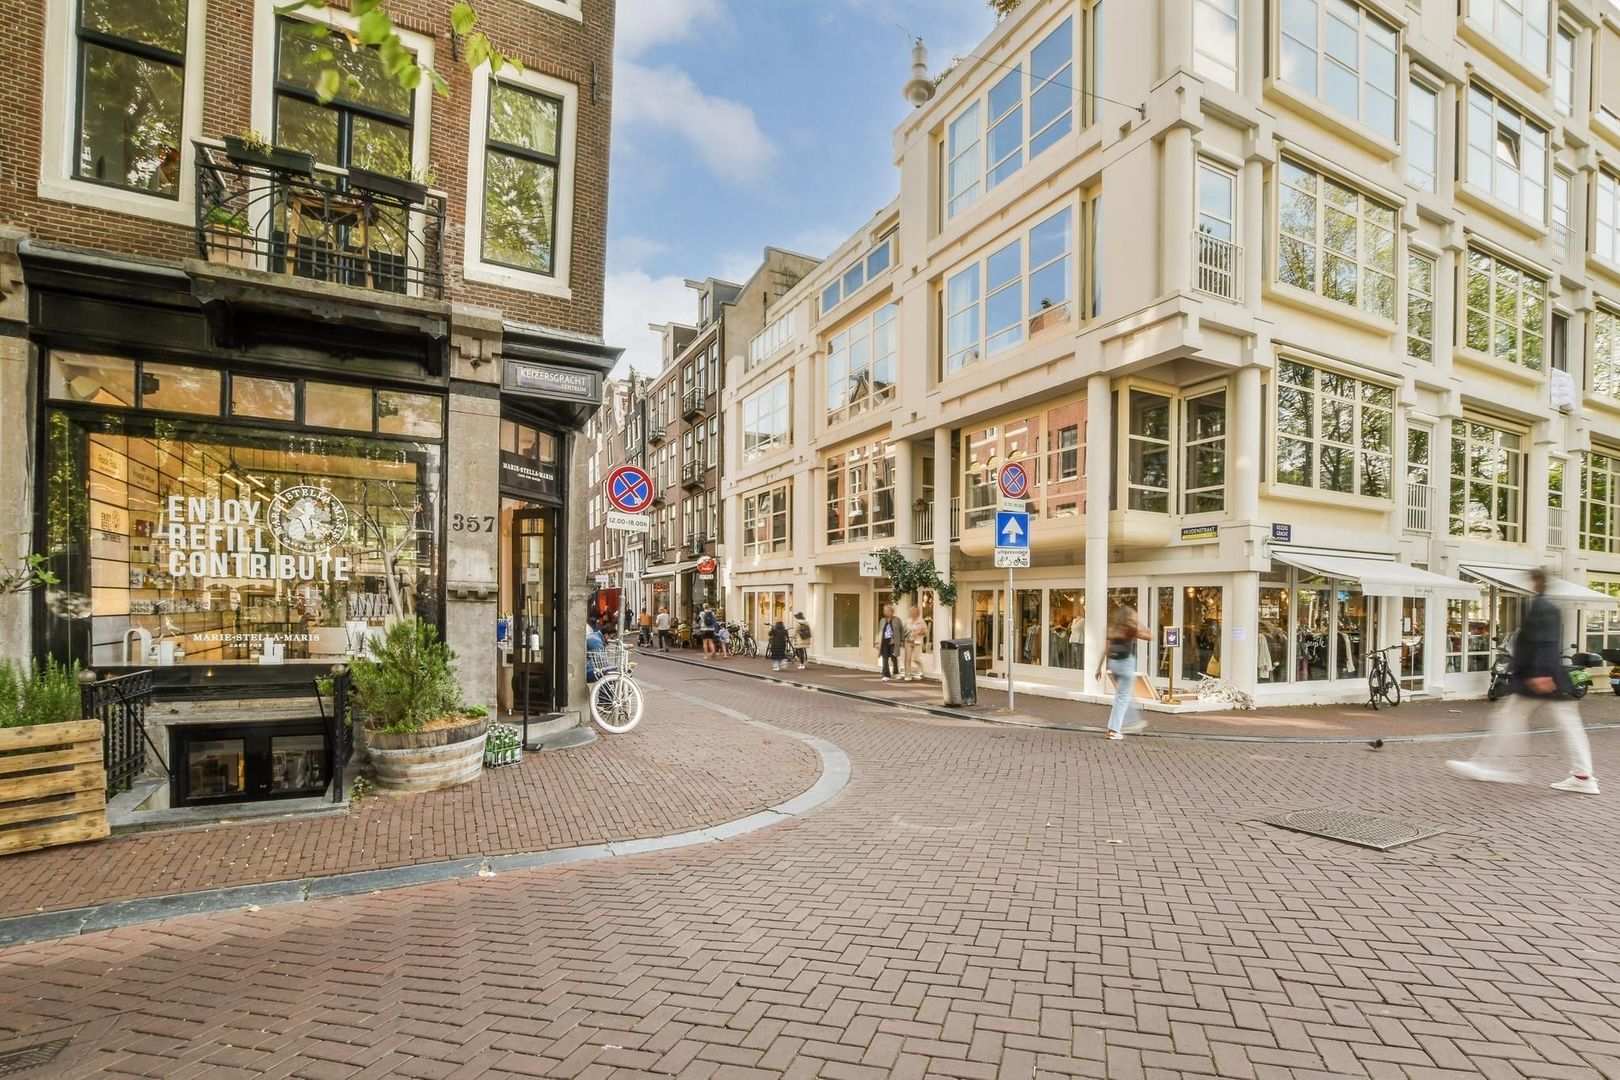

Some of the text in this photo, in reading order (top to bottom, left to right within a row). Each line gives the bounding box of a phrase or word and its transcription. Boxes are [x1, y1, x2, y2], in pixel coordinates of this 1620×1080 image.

[520, 369, 586, 386] KEIZERSGRACHT
[560, 383, 587, 393] CENTRUM
[503, 461, 553, 481] MARIE-STELLA-MARIS
[168, 495, 261, 526] ENJOY
[453, 513, 495, 532] 357
[168, 523, 270, 553] REFILL
[168, 551, 349, 581] CONTRIBUTE
[193, 633, 320, 642] MARIE-STELLA-MARIS
